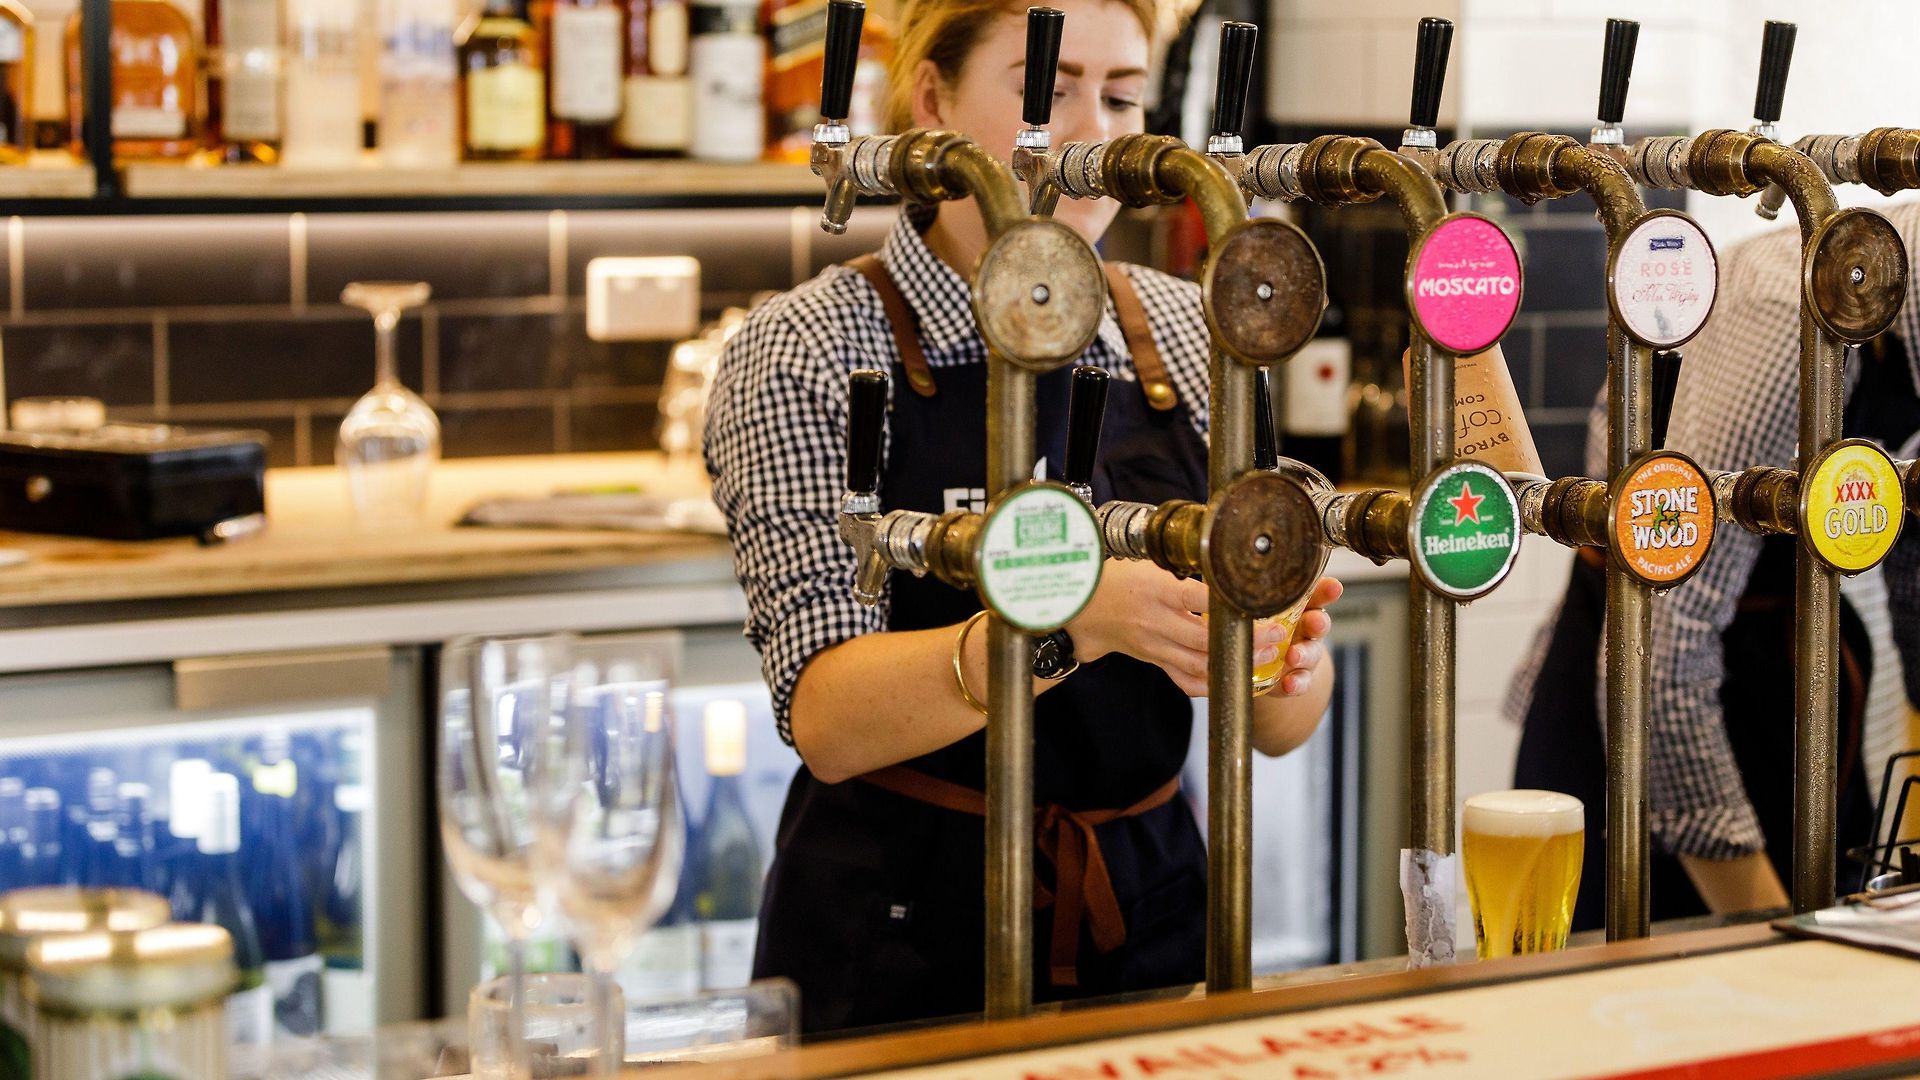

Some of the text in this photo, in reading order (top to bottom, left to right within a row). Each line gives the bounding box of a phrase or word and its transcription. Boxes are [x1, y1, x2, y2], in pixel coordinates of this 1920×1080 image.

[1418, 276, 1515, 297] MOSCATO
[1637, 463, 1694, 484] THE ORIGINAL
[1630, 486, 1698, 518] STONE
[1835, 481, 1878, 503] XXXX
[1824, 504, 1888, 539] GOLD
[1425, 530, 1511, 556] Heineken
[1631, 521, 1698, 550] WOOD
[1637, 553, 1693, 575] PACIFIC ALE
